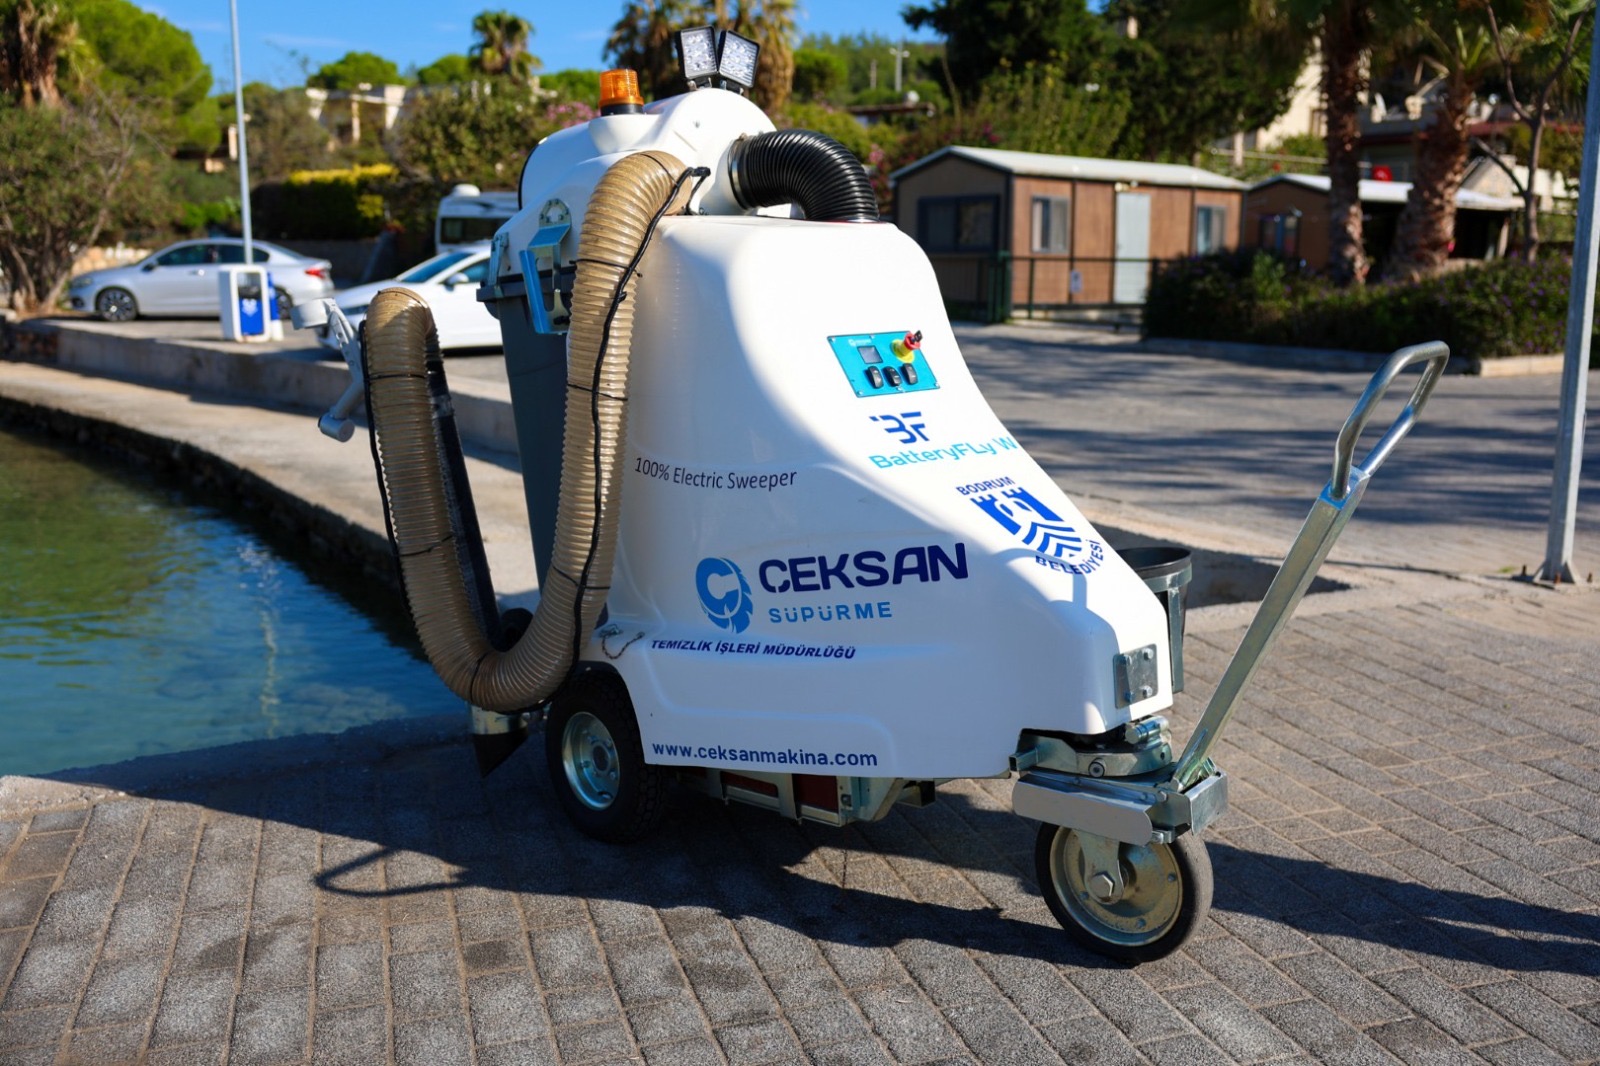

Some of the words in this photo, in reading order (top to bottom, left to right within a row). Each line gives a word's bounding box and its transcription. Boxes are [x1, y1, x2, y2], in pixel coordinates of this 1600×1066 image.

[634, 457, 670, 481] 100%
[673, 467, 723, 489] Electric
[727, 470, 798, 492] Sweeper
[955, 476, 1016, 496] BODRUM
[1035, 539, 1105, 575] BELEDİYESİ
[768, 601, 893, 623] SÜPÜRME
[651, 639, 713, 652] TEMİZLİK
[715, 640, 761, 655] İŞLERİ
[762, 643, 856, 660] MÜDÜRLÜĞÜ
[652, 742, 878, 767] www.ceksanmakina.com
